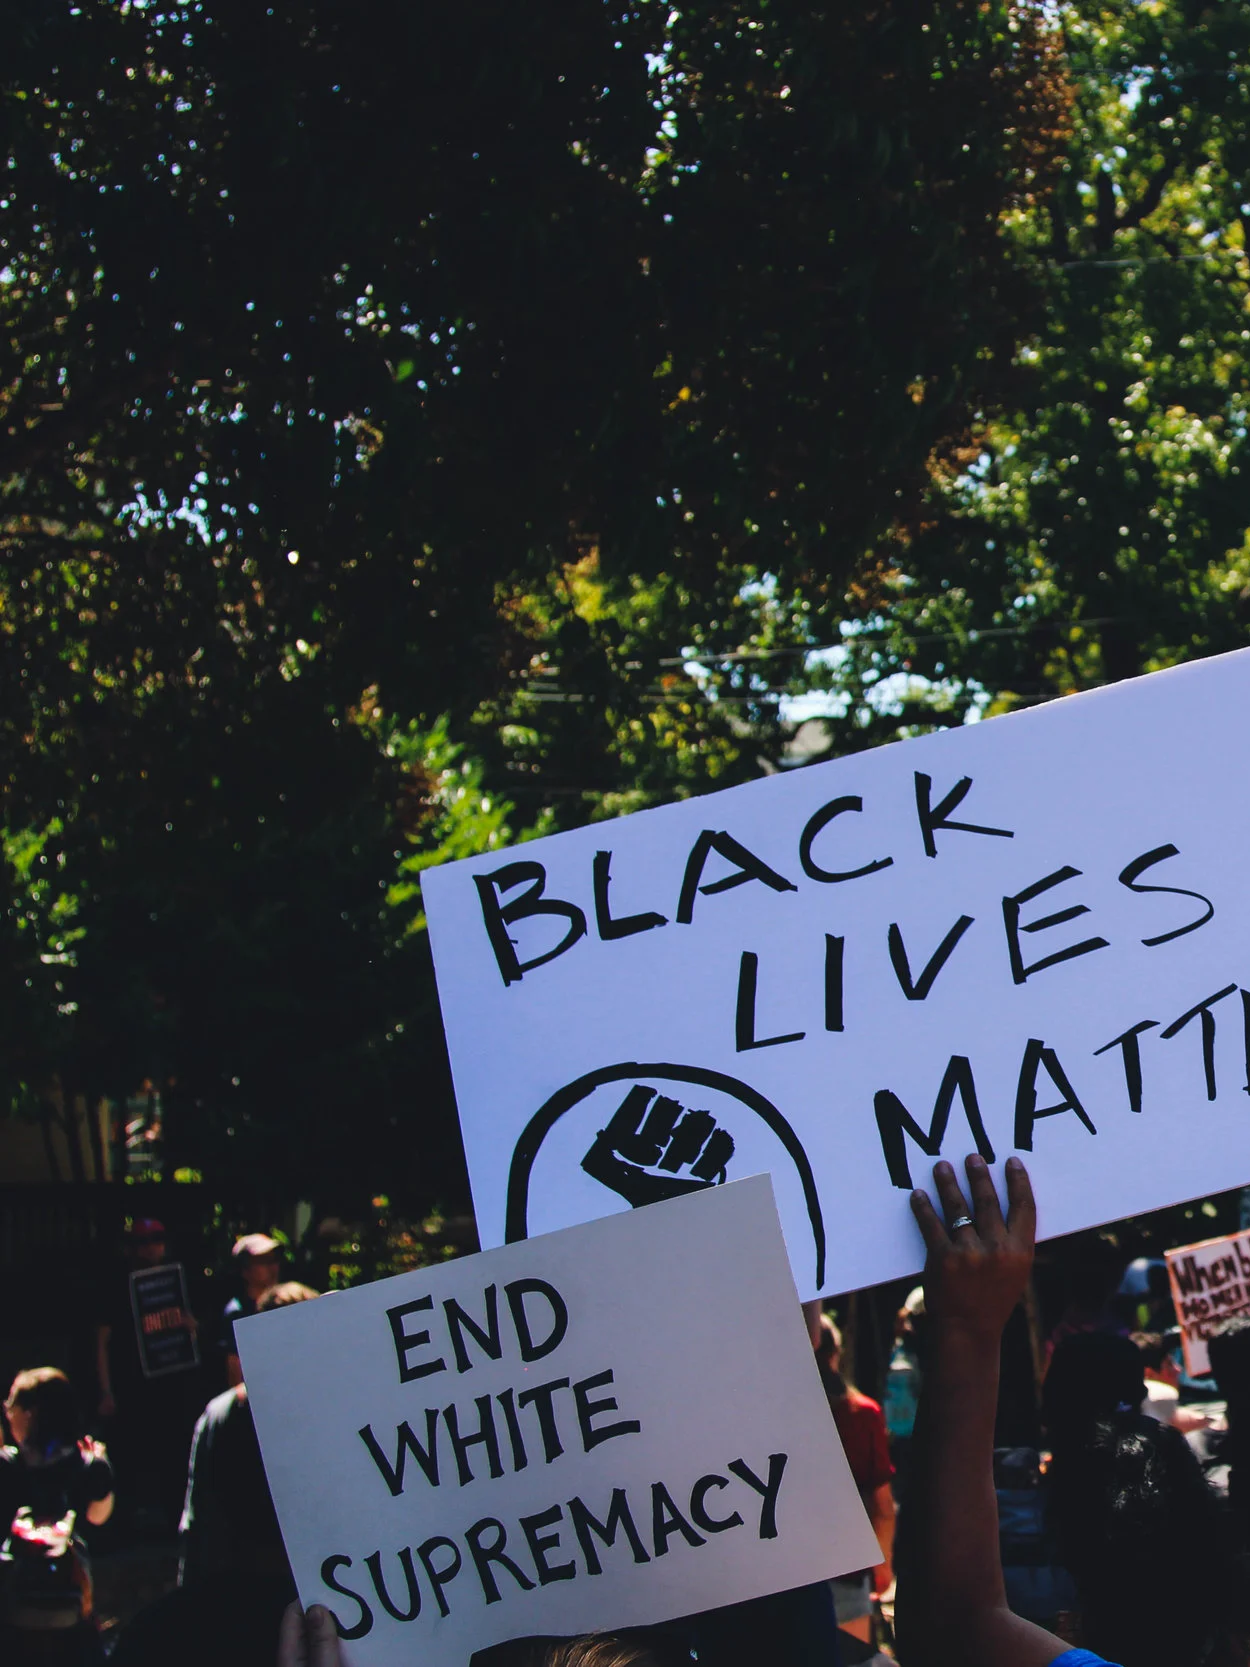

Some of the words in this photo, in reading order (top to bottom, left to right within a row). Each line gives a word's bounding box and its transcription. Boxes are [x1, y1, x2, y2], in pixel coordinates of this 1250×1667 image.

[472, 771, 1014, 986] BLACK
[735, 843, 1214, 1052] LIVES
[385, 1278, 568, 1383] END
[357, 1368, 640, 1496] WHITE
[320, 1452, 787, 1640] SUPREMACY
